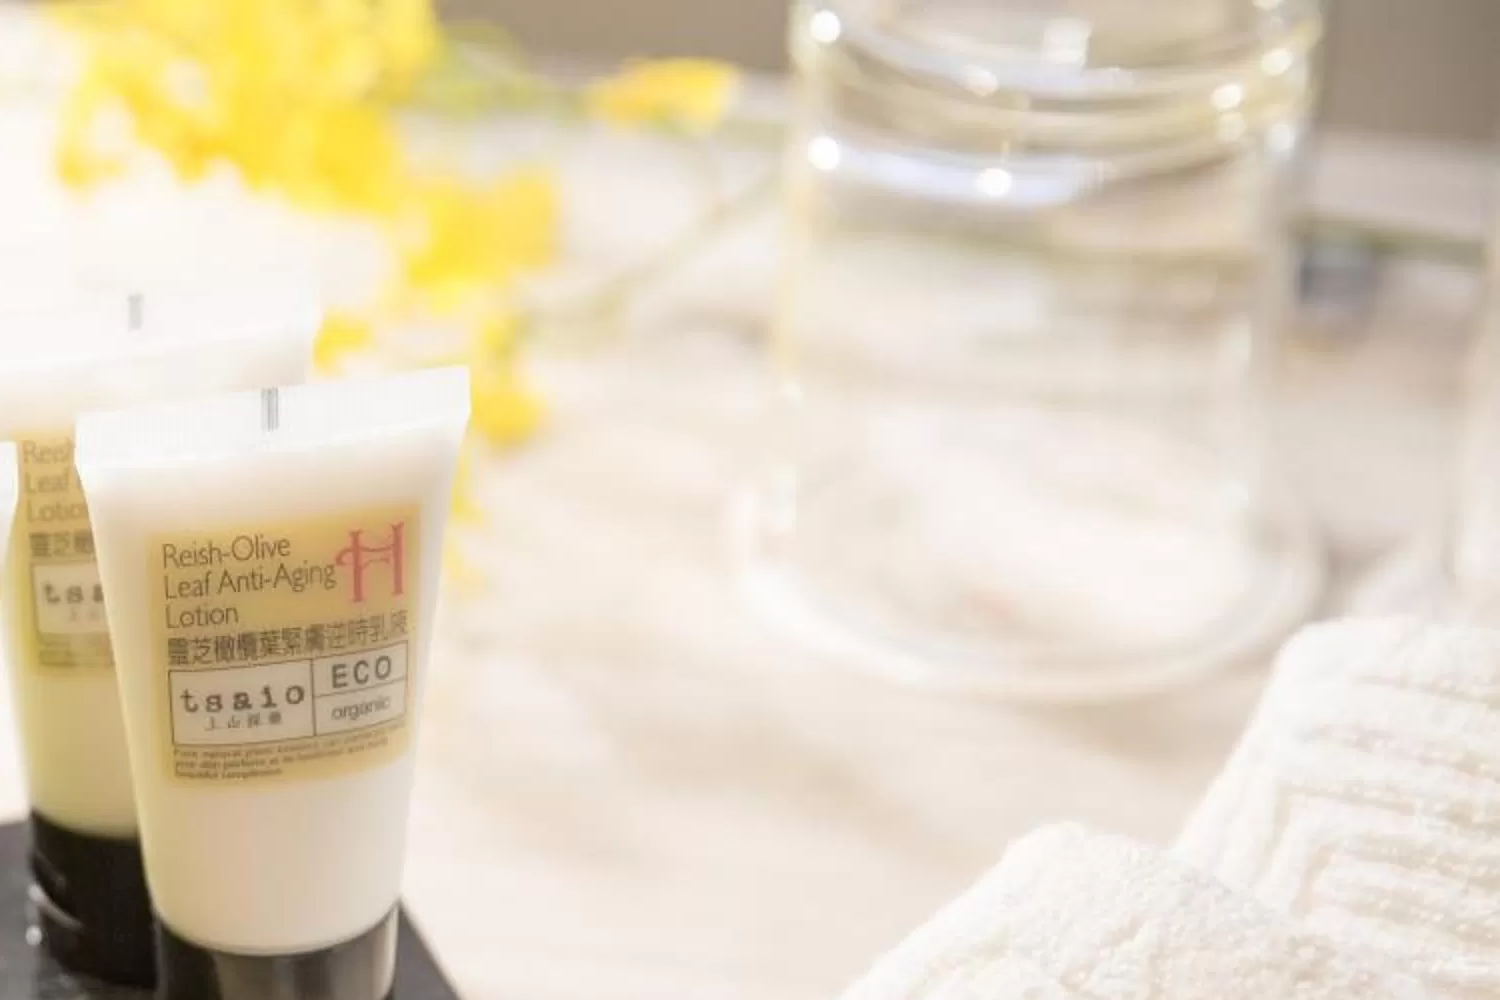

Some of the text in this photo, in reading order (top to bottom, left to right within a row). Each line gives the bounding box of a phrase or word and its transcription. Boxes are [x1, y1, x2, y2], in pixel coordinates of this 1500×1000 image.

[24, 468, 71, 494] Leaf
[161, 535, 292, 570] Reish-Olive
[163, 561, 338, 600] Leaf Anti-Aging
[165, 601, 240, 629] Lotion
[331, 654, 393, 689] ECO
[331, 693, 392, 721] organic
